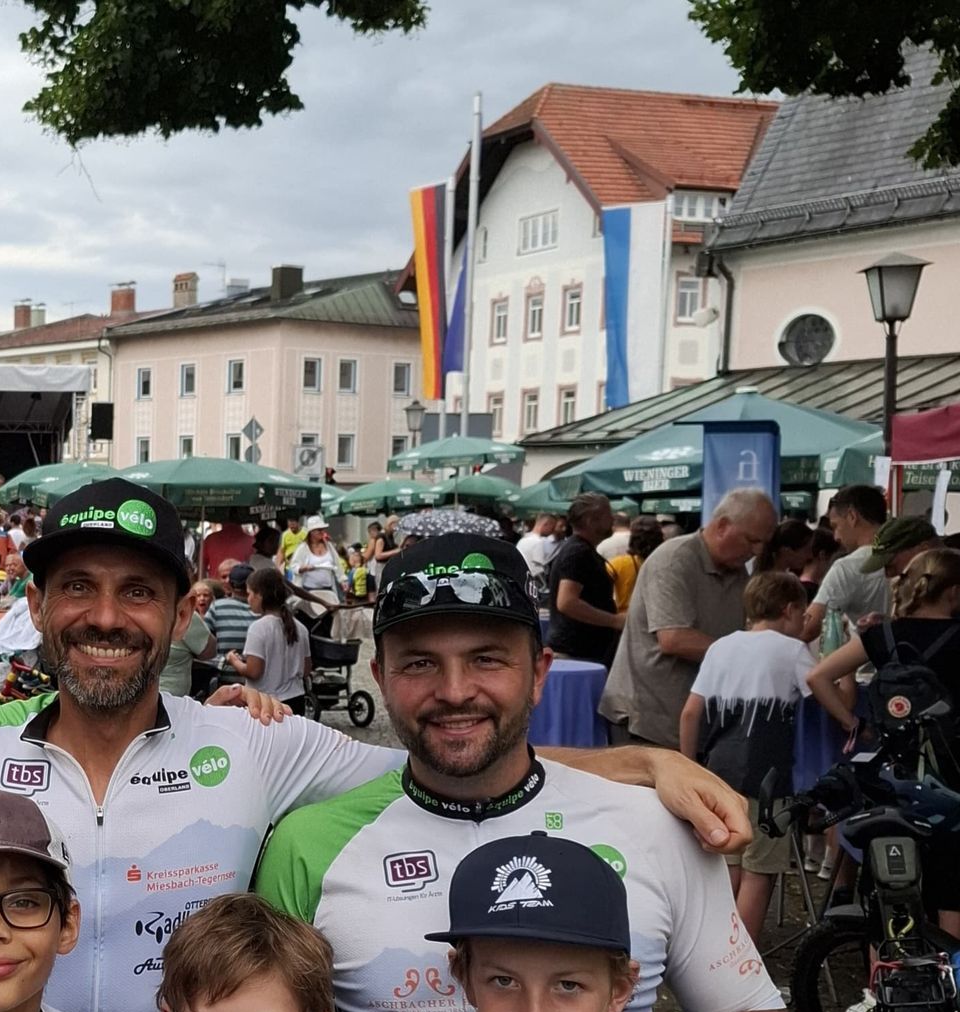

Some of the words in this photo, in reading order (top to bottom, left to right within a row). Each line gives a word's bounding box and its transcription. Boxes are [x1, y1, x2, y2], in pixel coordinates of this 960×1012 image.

[623, 465, 689, 482] WIENINGER
[642, 479, 670, 492] BIER
[60, 506, 115, 526] équipe
[120, 511, 154, 529] vélo
[10, 764, 42, 784] tbs
[130, 768, 189, 787] équipe
[191, 756, 228, 778] vélo
[159, 783, 190, 793] OBERLAND
[524, 773, 539, 793] vélo
[441, 802, 471, 813] vélo
[146, 863, 219, 881] Kreissparkasse
[393, 857, 429, 879] tbs
[146, 871, 236, 892] Miesbach-Tegernsee
[520, 900, 554, 909] TEAM
[368, 999, 456, 1009] ASCHBACHER
